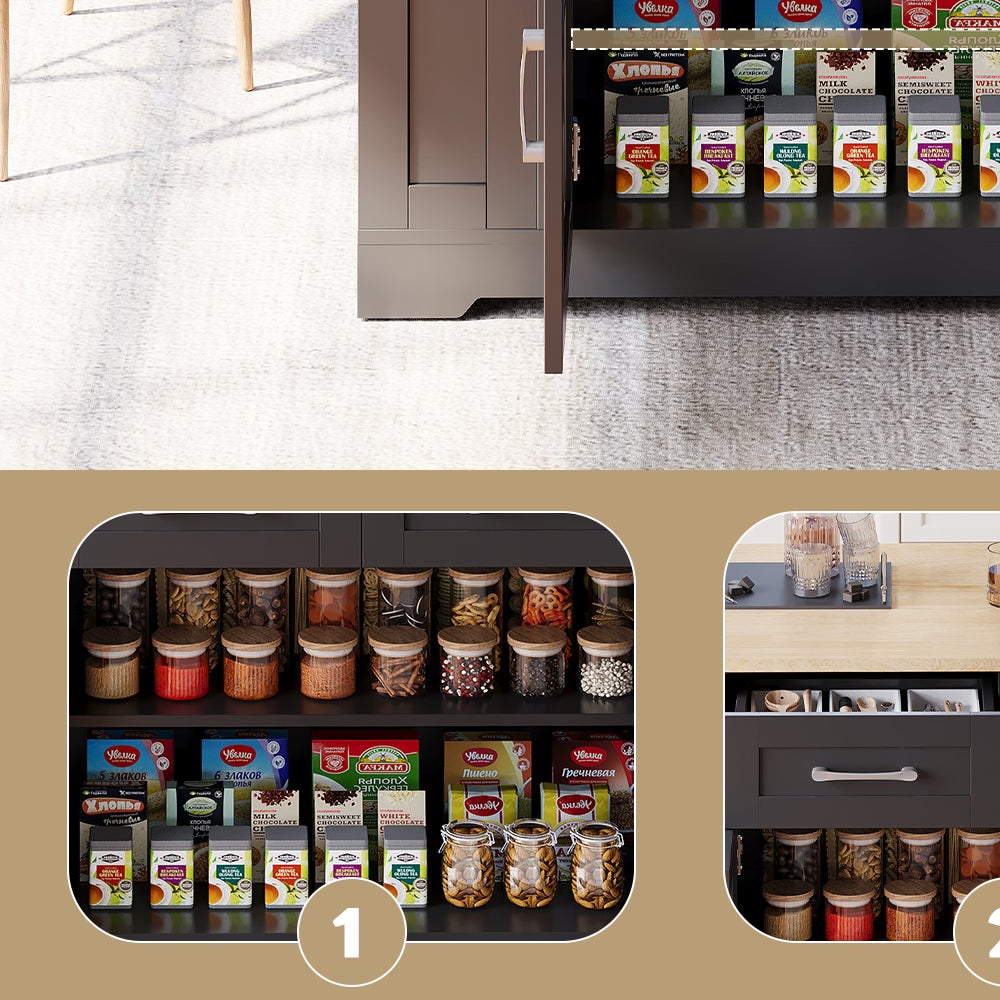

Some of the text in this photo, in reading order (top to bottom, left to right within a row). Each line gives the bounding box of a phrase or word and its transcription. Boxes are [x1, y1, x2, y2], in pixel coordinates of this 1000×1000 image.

[637, 0, 675, 15] Увелка
[781, 0, 818, 14] Увелка
[99, 770, 147, 781] 5 злаков
[214, 769, 262, 780] 6 злаков
[462, 768, 498, 778] Пшено
[561, 767, 616, 778] Гречневая
